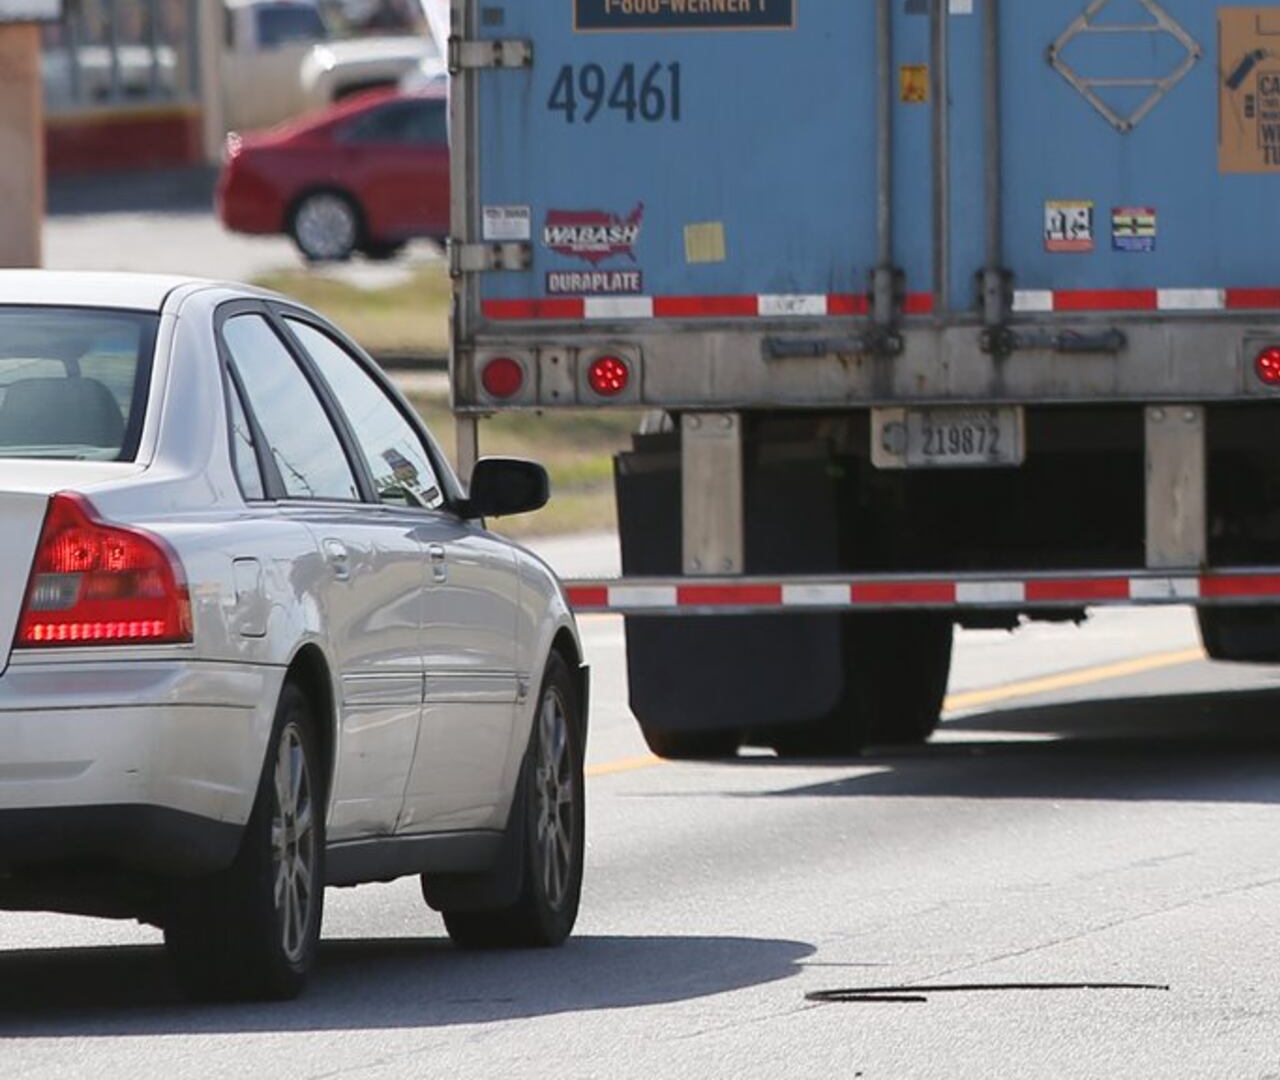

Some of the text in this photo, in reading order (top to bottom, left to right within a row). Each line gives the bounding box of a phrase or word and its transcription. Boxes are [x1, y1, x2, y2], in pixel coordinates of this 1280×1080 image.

[547, 62, 681, 124] 49461
[544, 225, 640, 244] WABASH
[549, 273, 640, 291] DURAPLATE
[922, 427, 1000, 455] 219872
